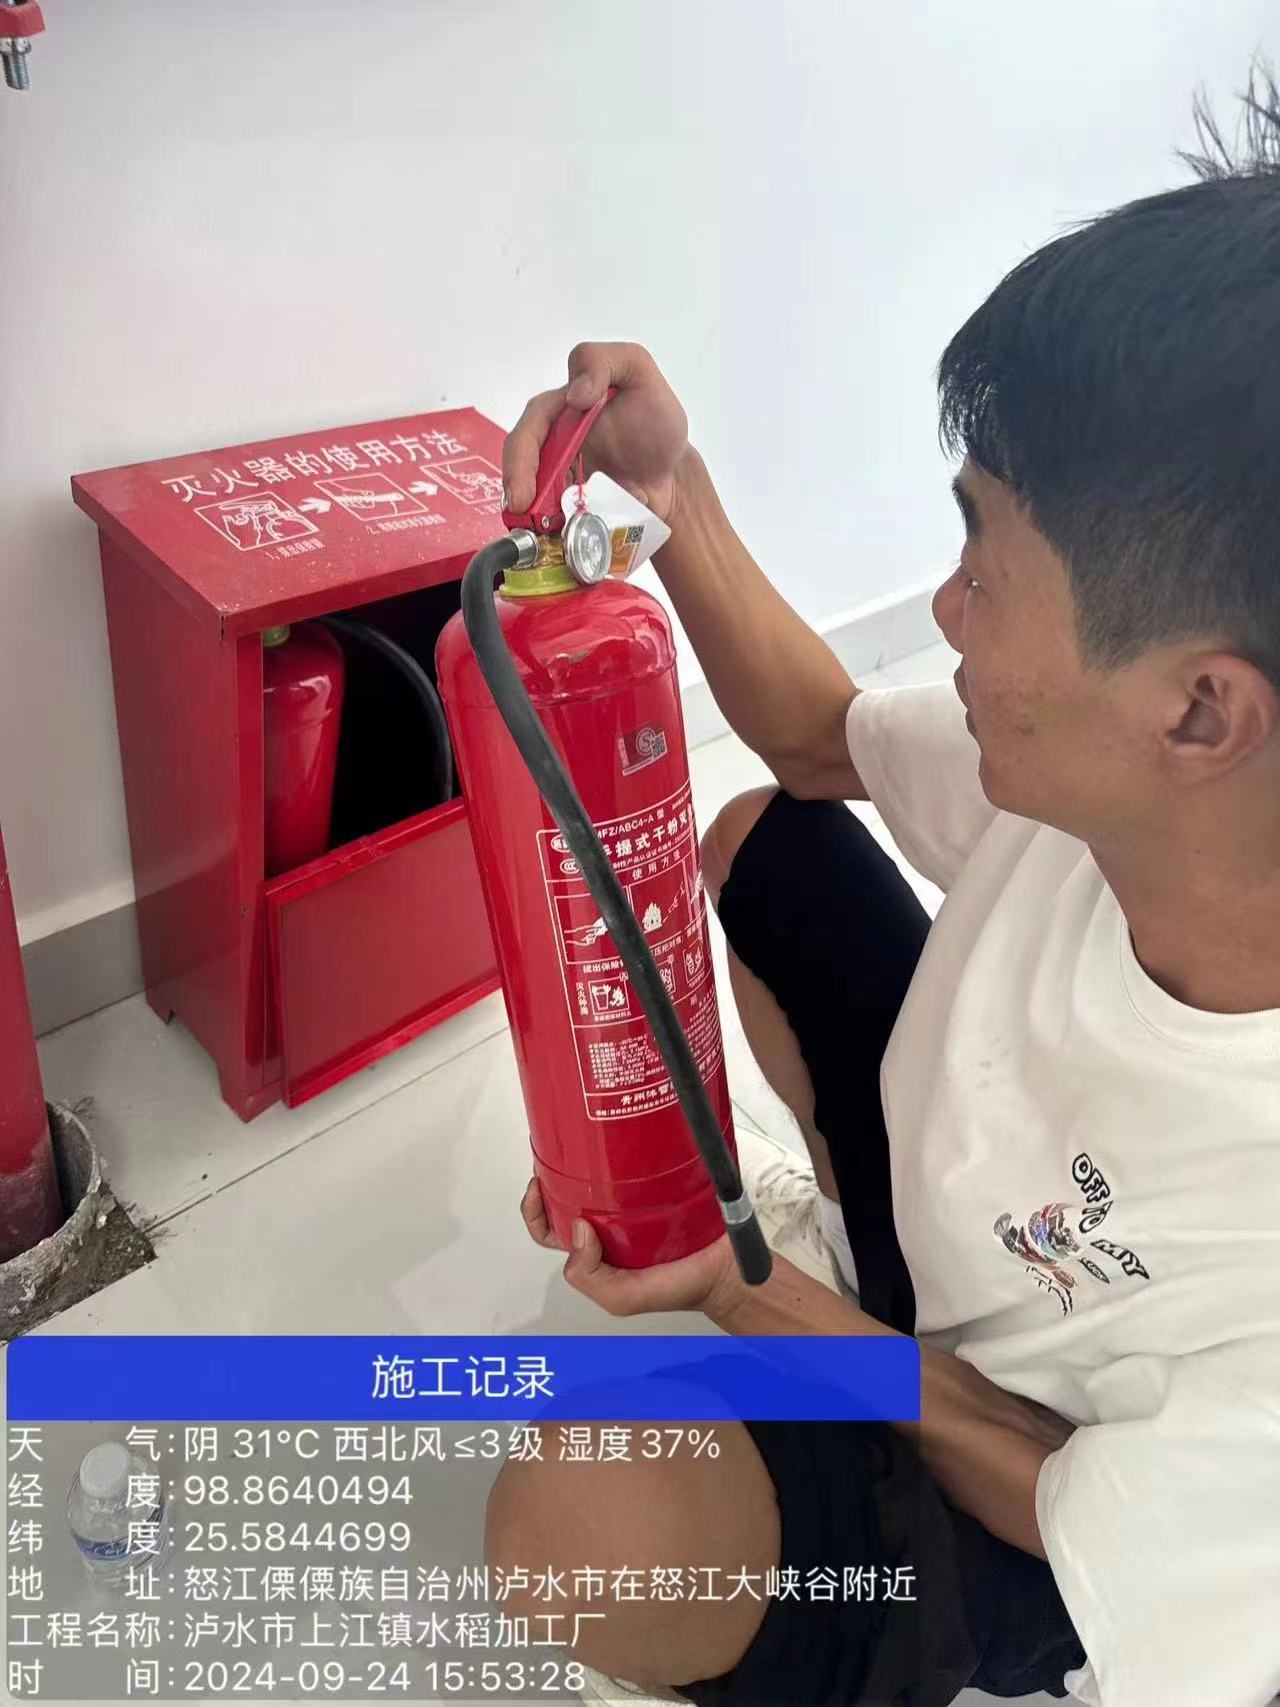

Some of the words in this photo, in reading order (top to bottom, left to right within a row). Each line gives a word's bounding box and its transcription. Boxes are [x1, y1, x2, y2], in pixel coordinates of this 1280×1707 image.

[161, 429, 468, 503] 灭火器的使用方法
[1072, 1152, 1111, 1203] OFF
